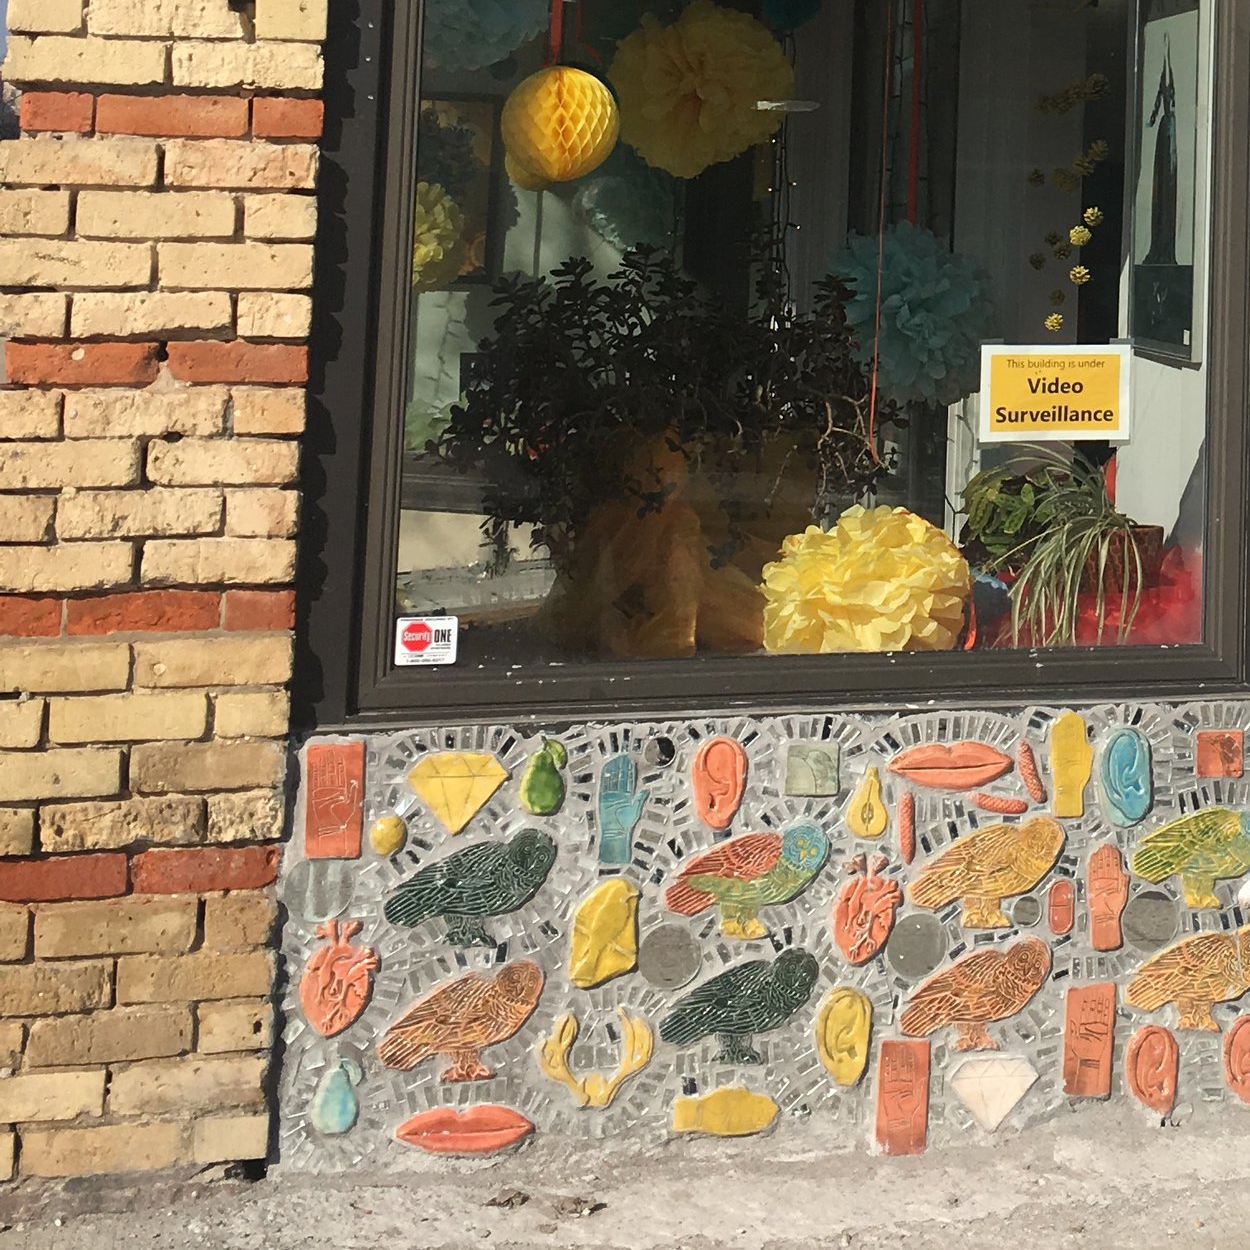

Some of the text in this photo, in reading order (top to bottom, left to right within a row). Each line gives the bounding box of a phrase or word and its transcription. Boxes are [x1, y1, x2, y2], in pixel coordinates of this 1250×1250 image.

[1007, 359, 1105, 370] This building is under
[1028, 377, 1084, 394] Video
[996, 406, 1113, 423] Surveillance
[434, 629, 452, 643] ONE
